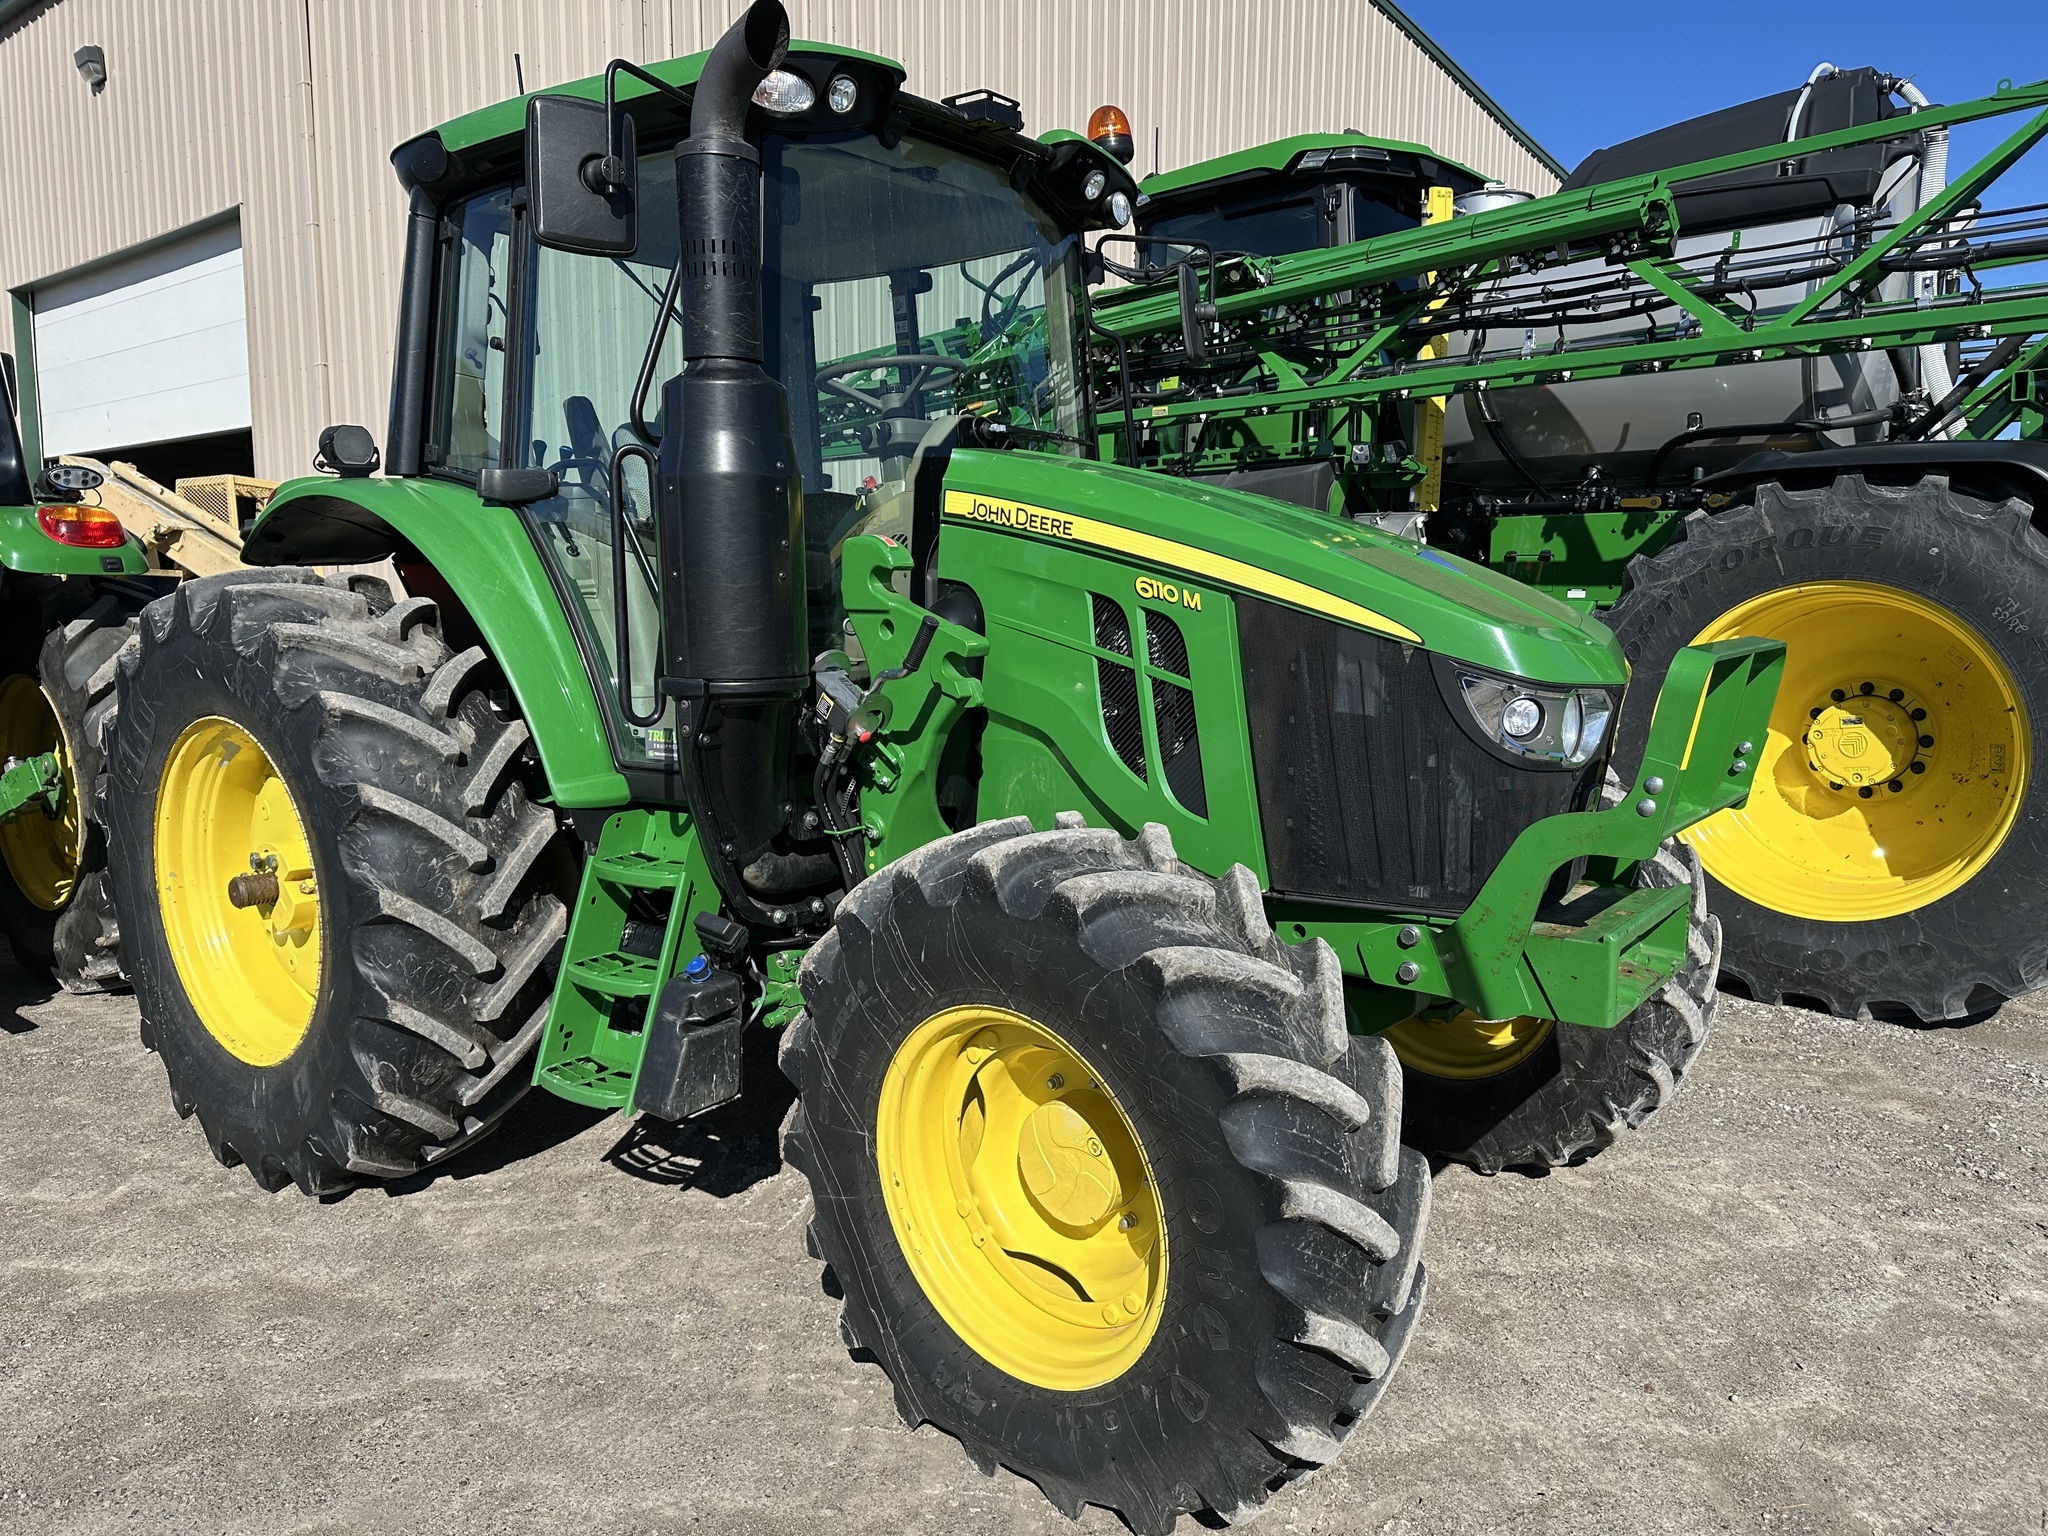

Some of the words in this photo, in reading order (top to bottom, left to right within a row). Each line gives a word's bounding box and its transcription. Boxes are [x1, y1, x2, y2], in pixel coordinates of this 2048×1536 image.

[967, 499, 1011, 523] JOHN
[1016, 507, 1074, 537] DEERE
[1135, 576, 1178, 603] 6110
[1183, 589, 1202, 611] M
